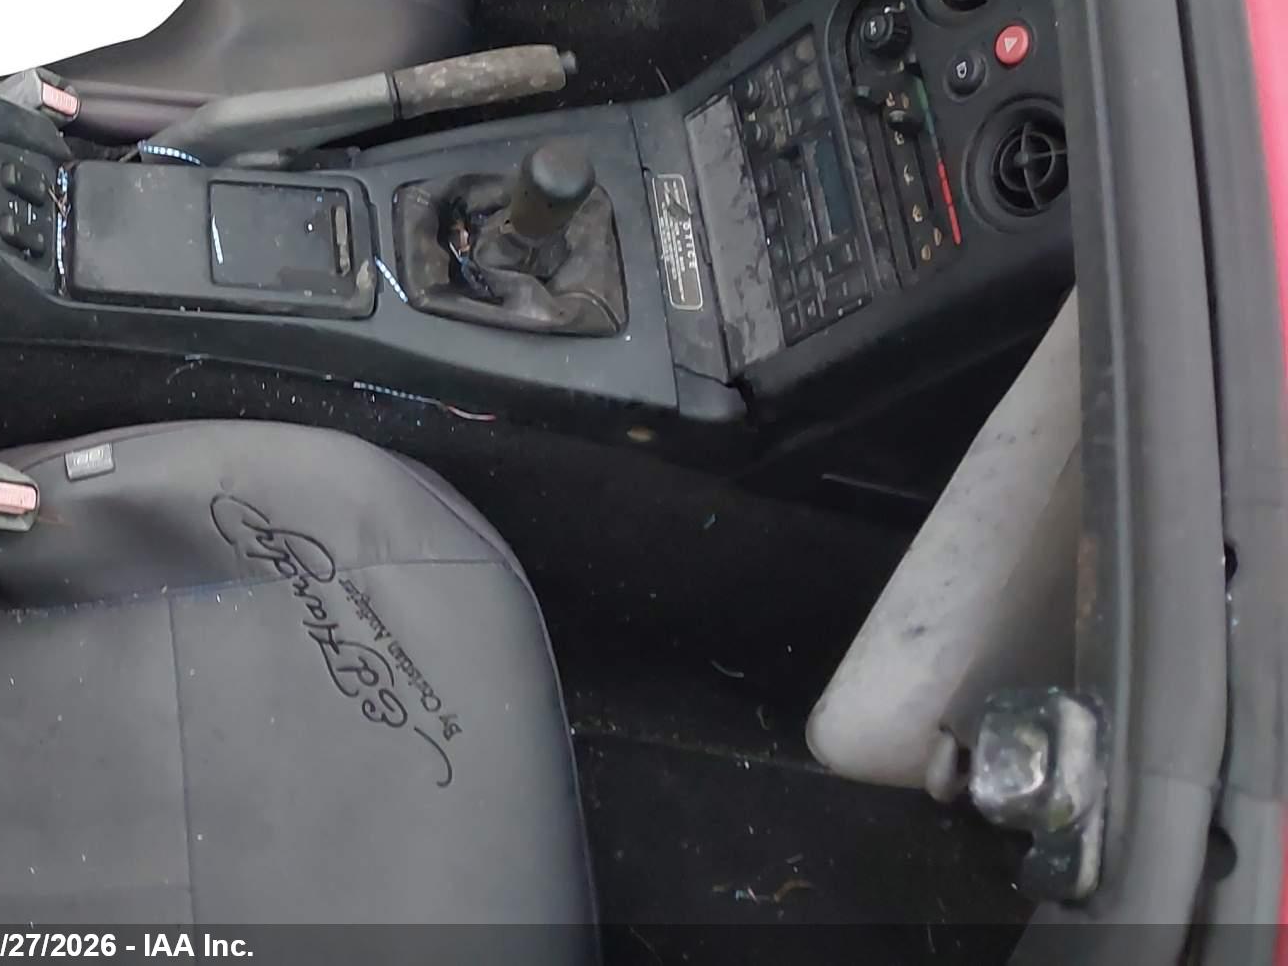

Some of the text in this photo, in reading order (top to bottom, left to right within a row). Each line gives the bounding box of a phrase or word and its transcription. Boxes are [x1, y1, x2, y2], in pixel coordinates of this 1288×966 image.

[682, 221, 698, 269] OTICE
[210, 494, 394, 698] Hardy
[438, 713, 462, 740] By
